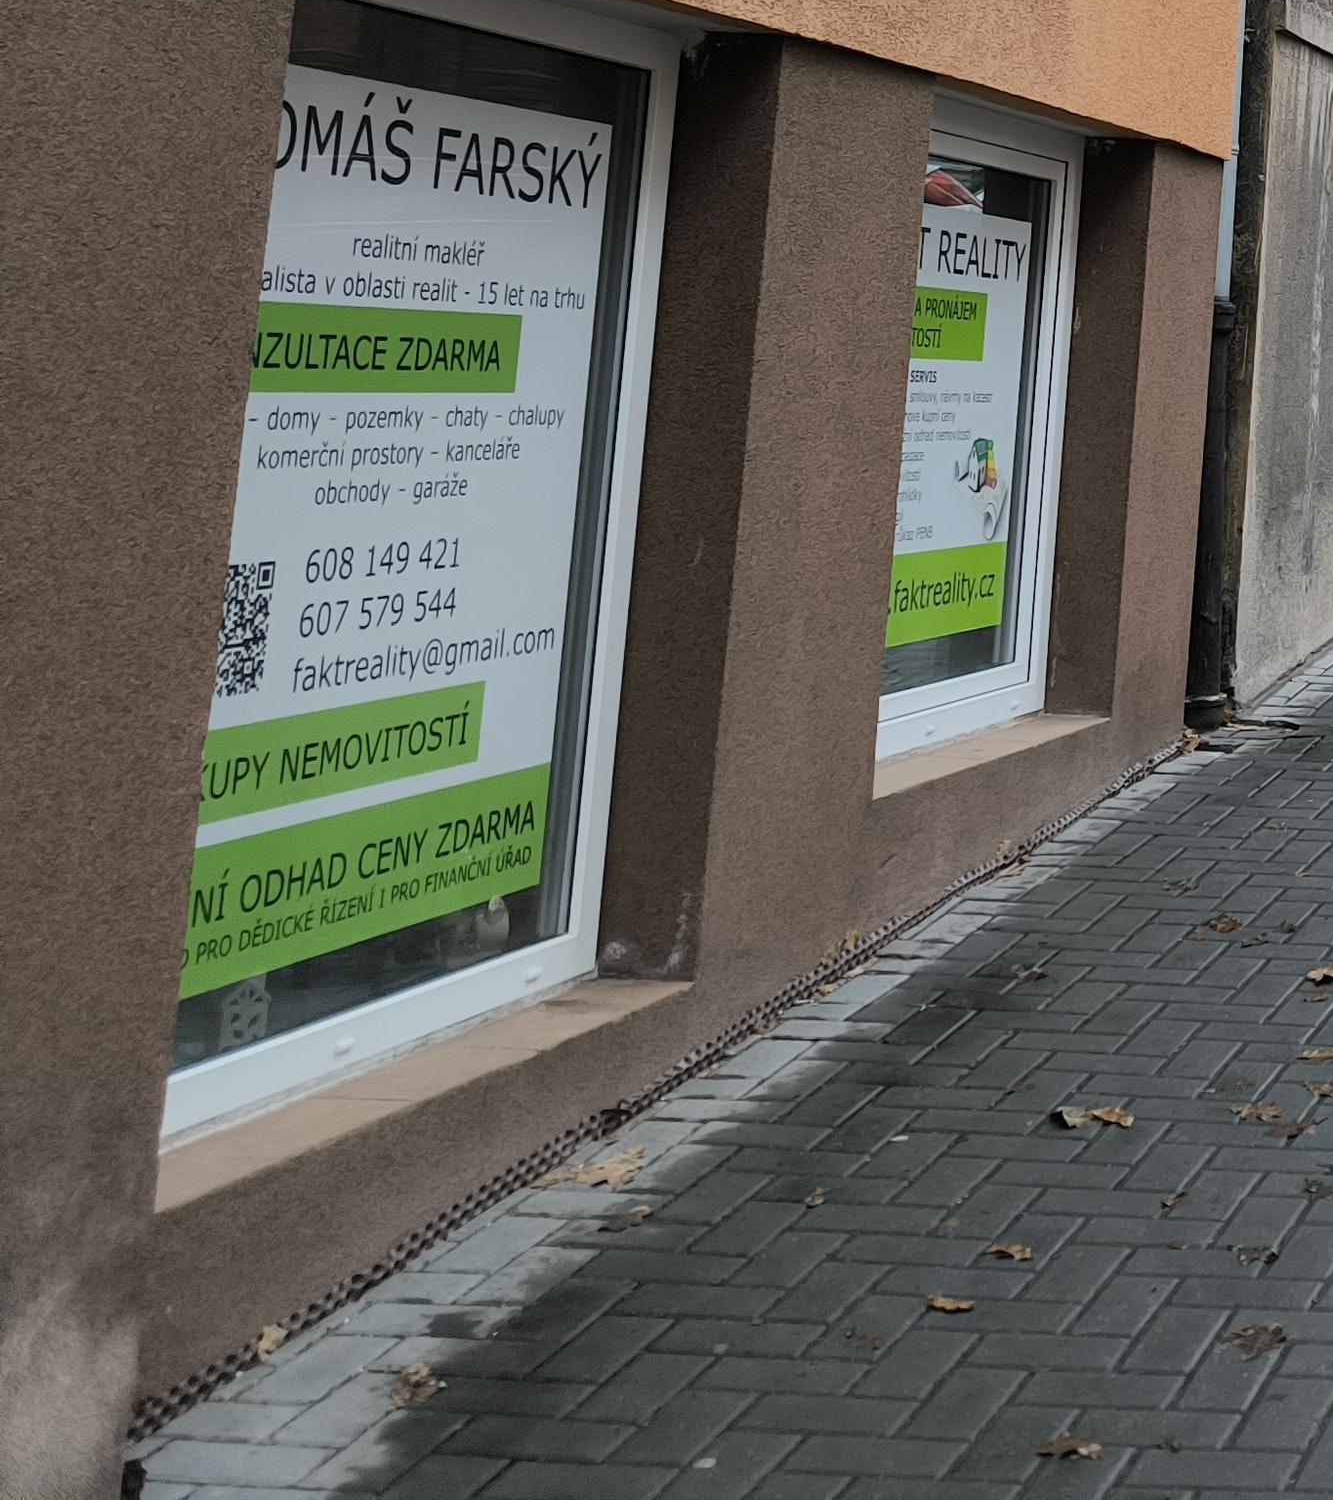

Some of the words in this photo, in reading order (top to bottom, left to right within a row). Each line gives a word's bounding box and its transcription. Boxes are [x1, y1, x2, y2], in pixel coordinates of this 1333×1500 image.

[433, 127, 603, 209] FARSKÝ
[352, 234, 420, 261] realitní
[424, 241, 486, 268] makléř
[937, 229, 1027, 282] REALITY
[261, 264, 316, 294] alista
[325, 275, 336, 296] v
[343, 271, 406, 299] oblasti
[412, 279, 457, 303] realit
[478, 281, 498, 306] 15
[503, 283, 524, 308] let
[530, 288, 548, 309] na
[554, 285, 586, 310] trhu
[914, 297, 922, 317] A
[925, 294, 977, 321] PRONÁJEM
[395, 337, 501, 372] ZDARMA
[911, 323, 943, 348] TOSTÍ
[909, 369, 937, 384] SERVIS
[267, 406, 321, 436] domy
[345, 406, 424, 435] pozemky
[445, 405, 489, 431] chaty
[508, 404, 566, 430] chalupy
[256, 440, 347, 470] komerční
[350, 441, 424, 472] prostory
[445, 436, 521, 462] kanceláře
[314, 479, 391, 507] obchody
[412, 472, 469, 504] garáže
[305, 546, 354, 584] 608
[365, 541, 411, 578] 149
[418, 537, 461, 570] 421
[299, 599, 350, 638] 607
[358, 592, 405, 630] 579
[413, 587, 457, 623] 544
[292, 626, 556, 694] faktreality@gmail.com
[279, 700, 472, 785] NEMOVITOSTÍ
[191, 867, 231, 928] NÍ
[239, 852, 348, 913] ODHAD
[358, 828, 429, 880] CENY
[435, 799, 536, 859] ZDARMA
[196, 934, 233, 965] PRO
[238, 903, 315, 952] DĚDICKÉ
[320, 883, 377, 927] ŘÍZENÍ
[380, 888, 386, 909] I
[391, 878, 421, 904] PRO
[424, 855, 493, 894] FINANČNÍ
[495, 844, 533, 874] ÚŘAD
